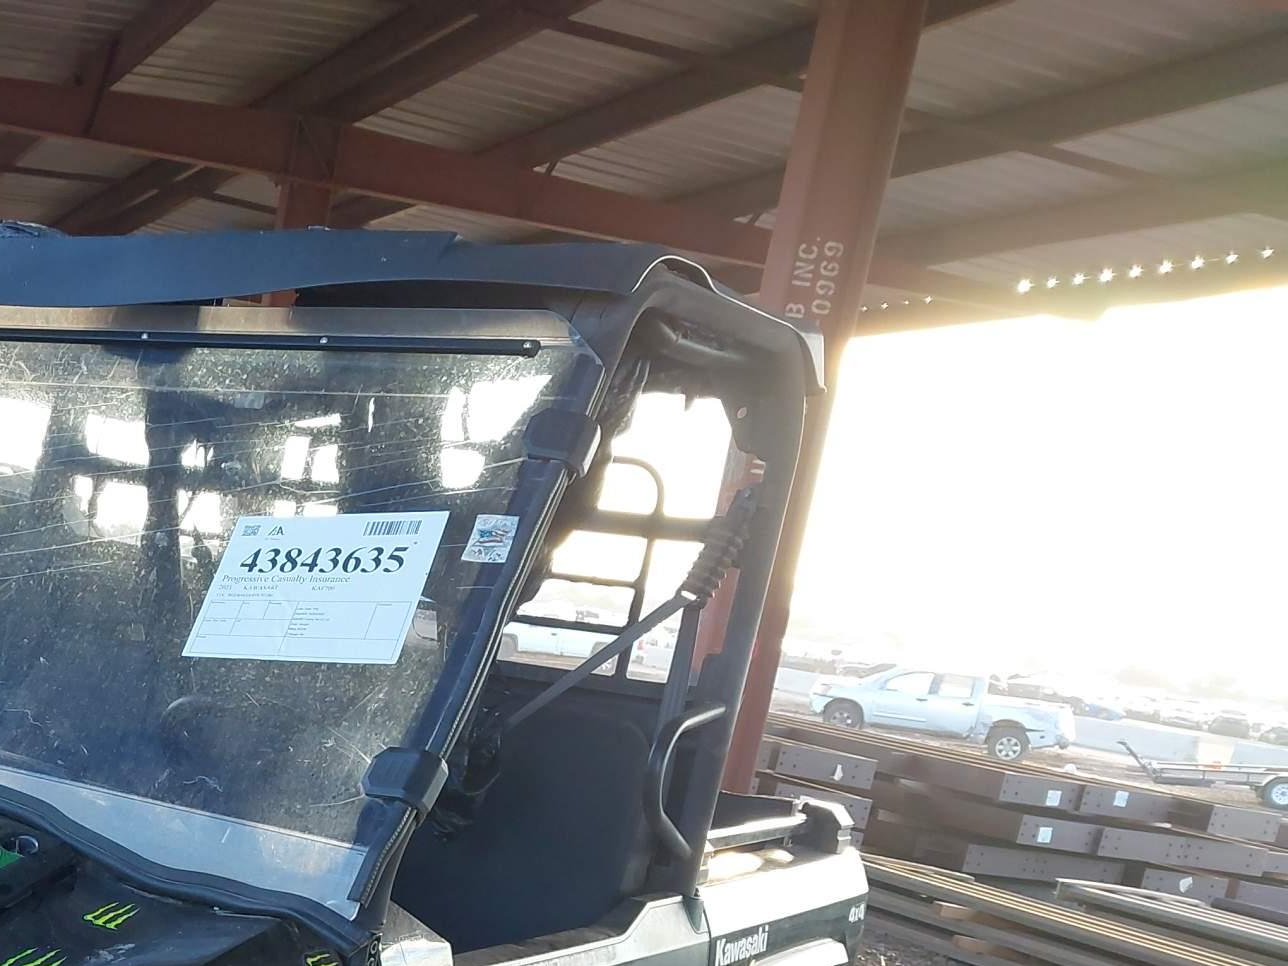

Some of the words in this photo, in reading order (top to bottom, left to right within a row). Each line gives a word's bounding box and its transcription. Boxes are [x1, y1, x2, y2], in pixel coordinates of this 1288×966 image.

[792, 236, 821, 287] INC.
[240, 546, 409, 574] 43843635
[222, 574, 270, 585] Progressive
[271, 574, 307, 584] Casualty
[309, 574, 351, 583] Insurance
